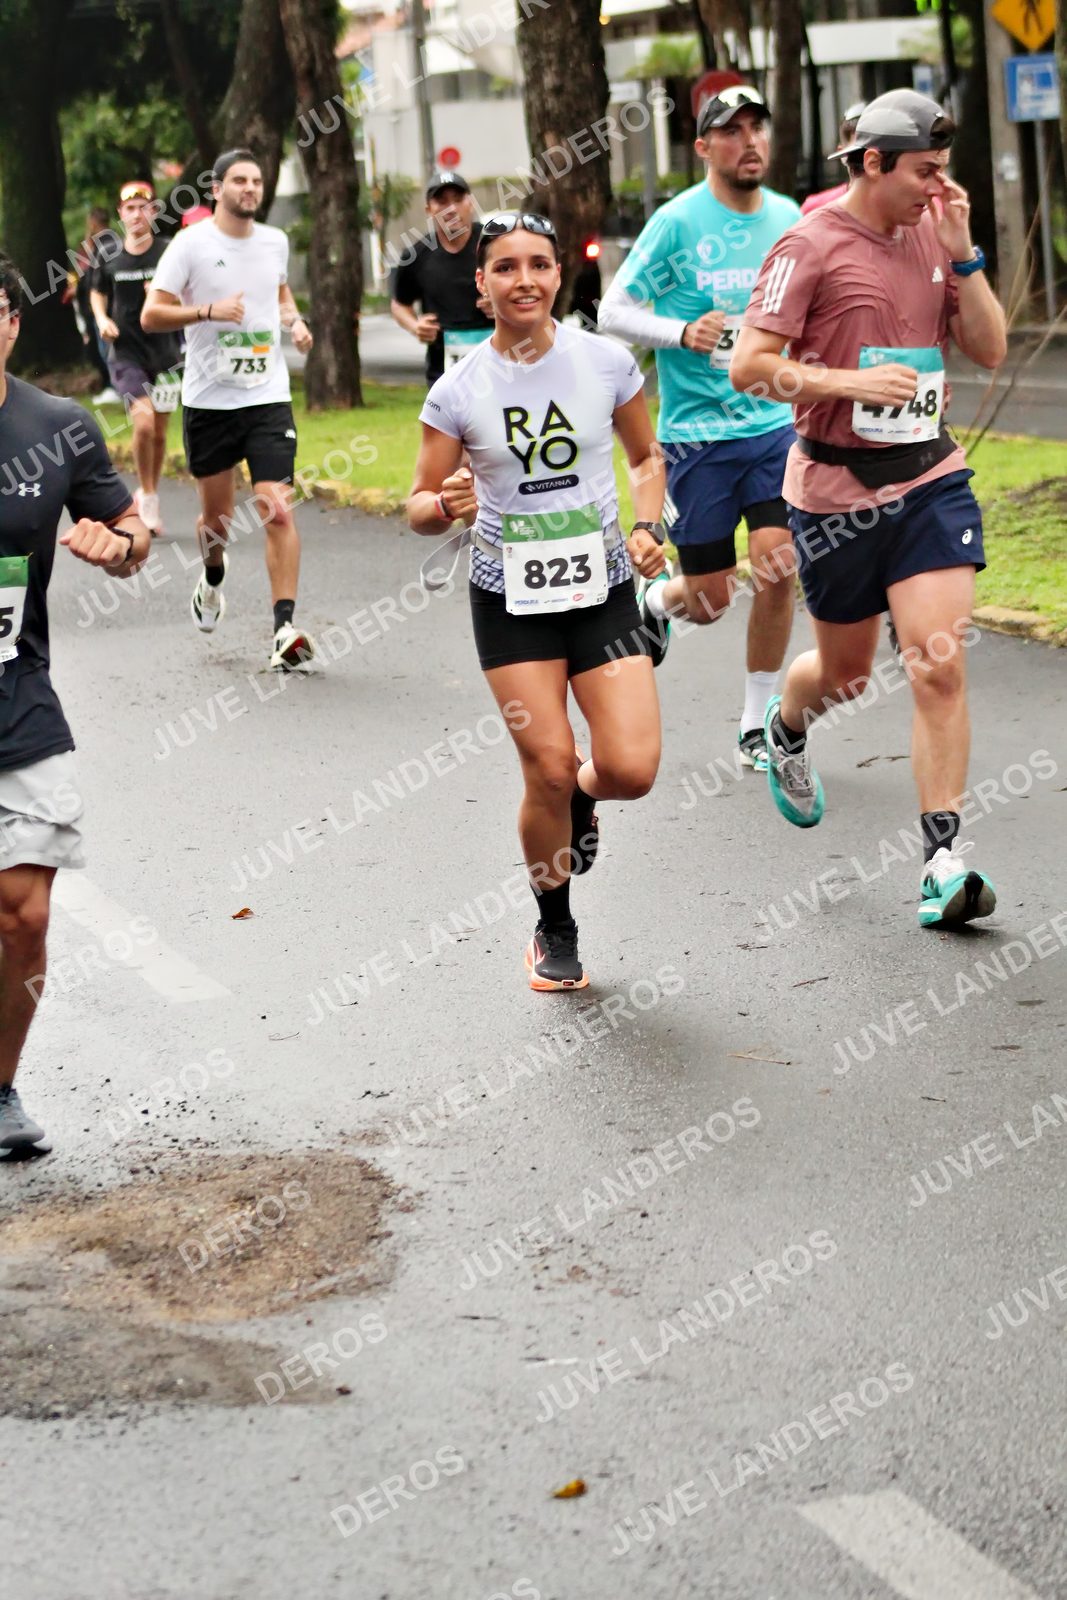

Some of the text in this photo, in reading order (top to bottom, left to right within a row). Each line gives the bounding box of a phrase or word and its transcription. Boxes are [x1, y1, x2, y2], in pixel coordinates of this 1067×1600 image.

[696, 267, 761, 292] PERD
[717, 329, 741, 351] 3
[230, 357, 267, 376] 733
[503, 400, 575, 443] RA
[508, 436, 578, 475] YO
[524, 553, 592, 589] 823
